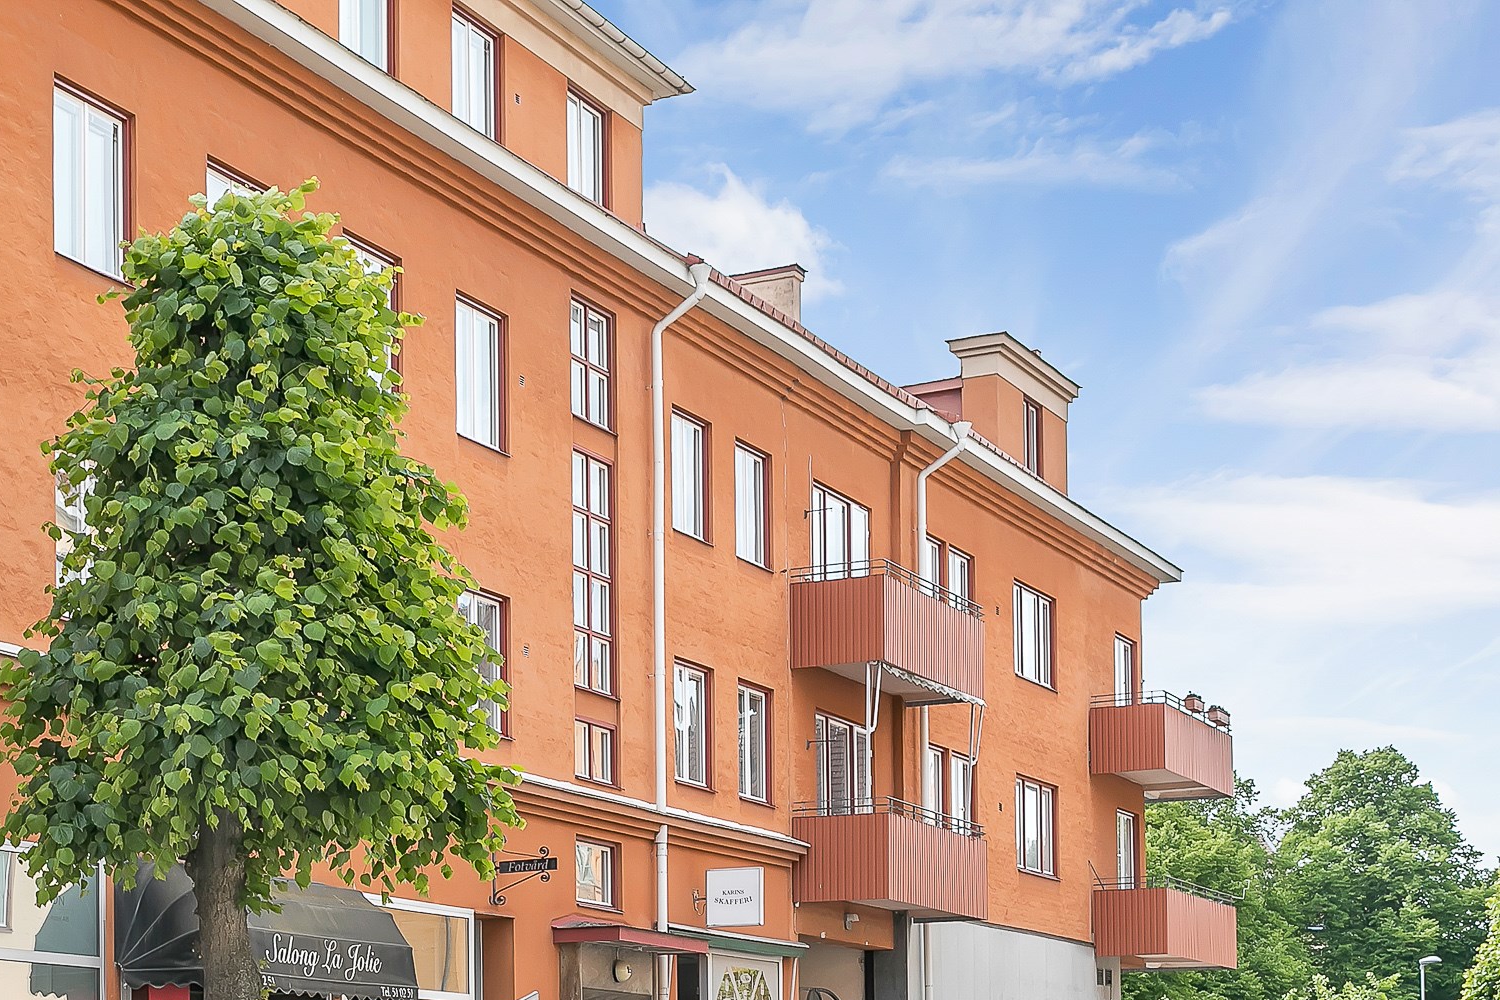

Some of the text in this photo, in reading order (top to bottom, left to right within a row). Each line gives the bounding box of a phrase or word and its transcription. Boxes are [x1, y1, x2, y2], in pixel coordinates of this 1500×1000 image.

[508, 859, 549, 872] Fotvård
[713, 895, 753, 905] SKAFFERI
[265, 933, 383, 981] Salong La Jolie
